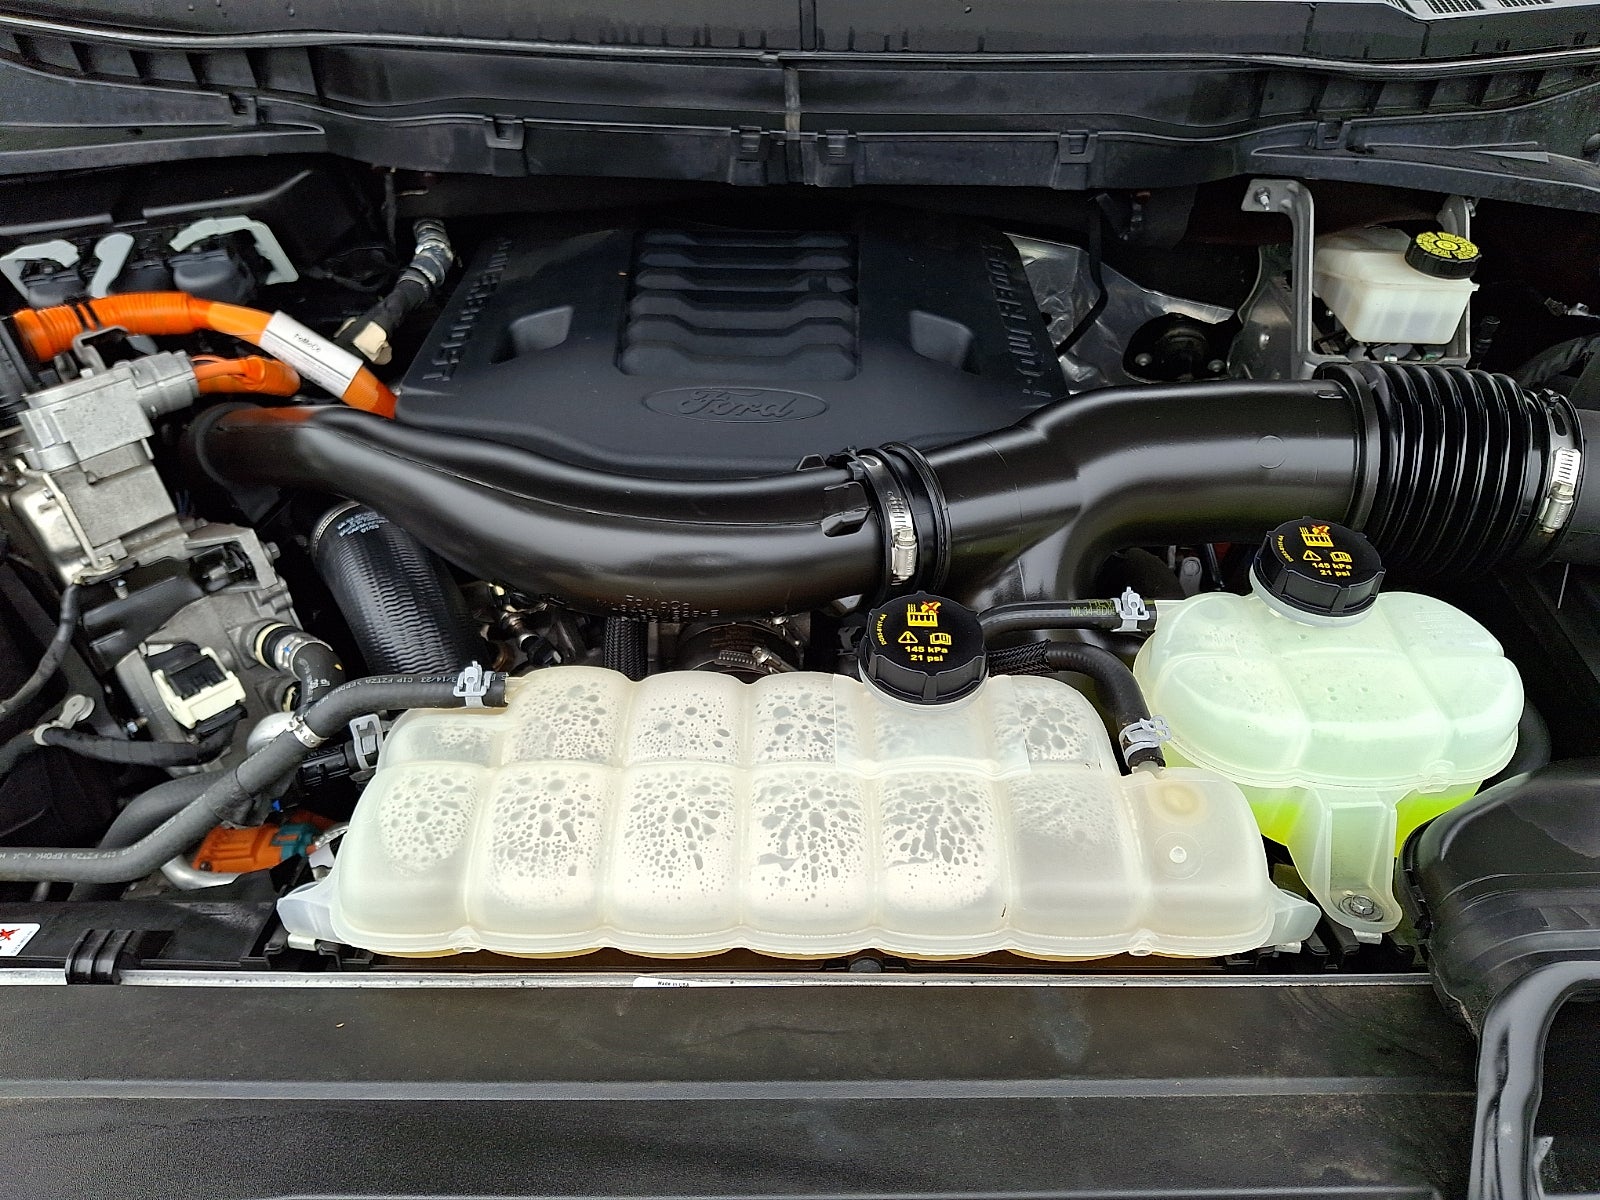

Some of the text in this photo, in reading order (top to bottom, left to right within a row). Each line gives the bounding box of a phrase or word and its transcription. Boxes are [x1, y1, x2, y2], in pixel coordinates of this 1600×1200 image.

[676, 390, 798, 419] Ford
[1331, 562, 1352, 570] kPa
[927, 646, 949, 654] kPa
[926, 654, 944, 663] psi
